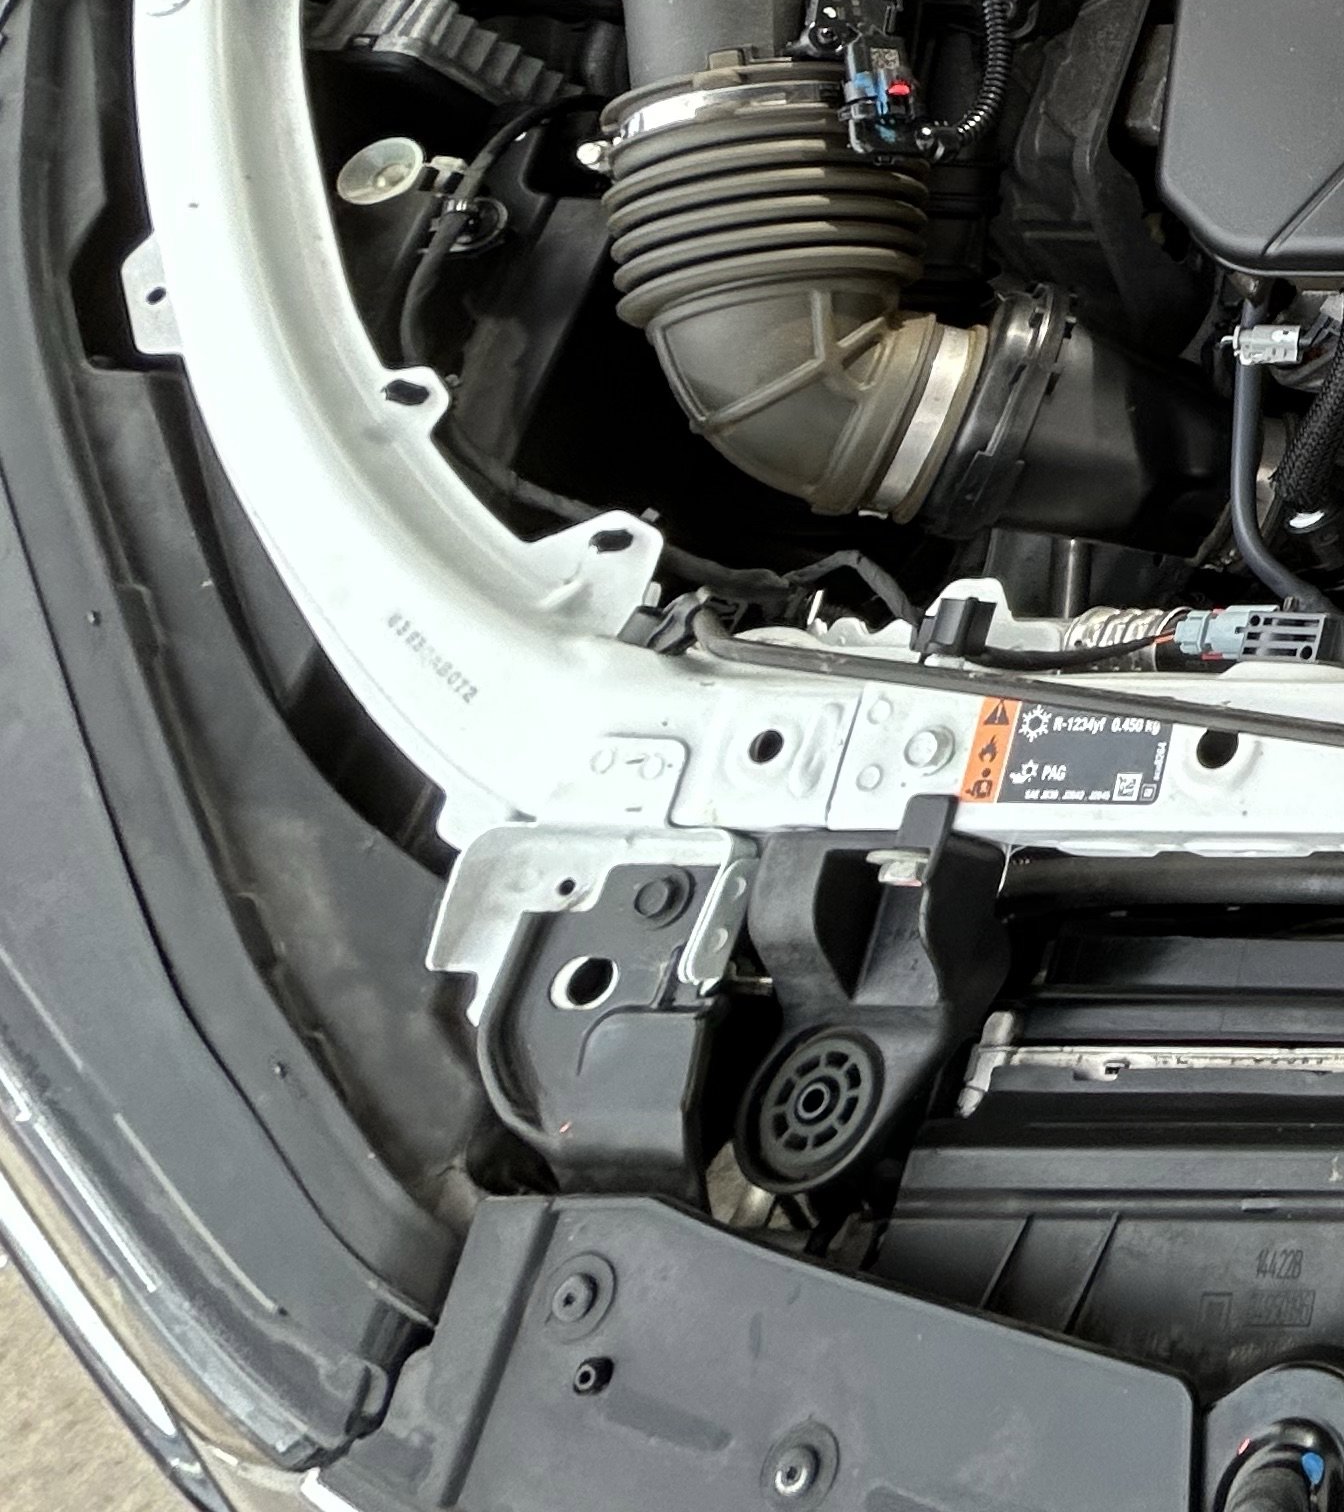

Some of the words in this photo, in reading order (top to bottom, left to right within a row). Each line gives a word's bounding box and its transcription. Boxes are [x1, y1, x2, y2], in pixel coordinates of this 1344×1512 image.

[1052, 716, 1107, 735] R-1234yf
[1111, 717, 1144, 733] 0.450
[1041, 764, 1067, 781] PAG
